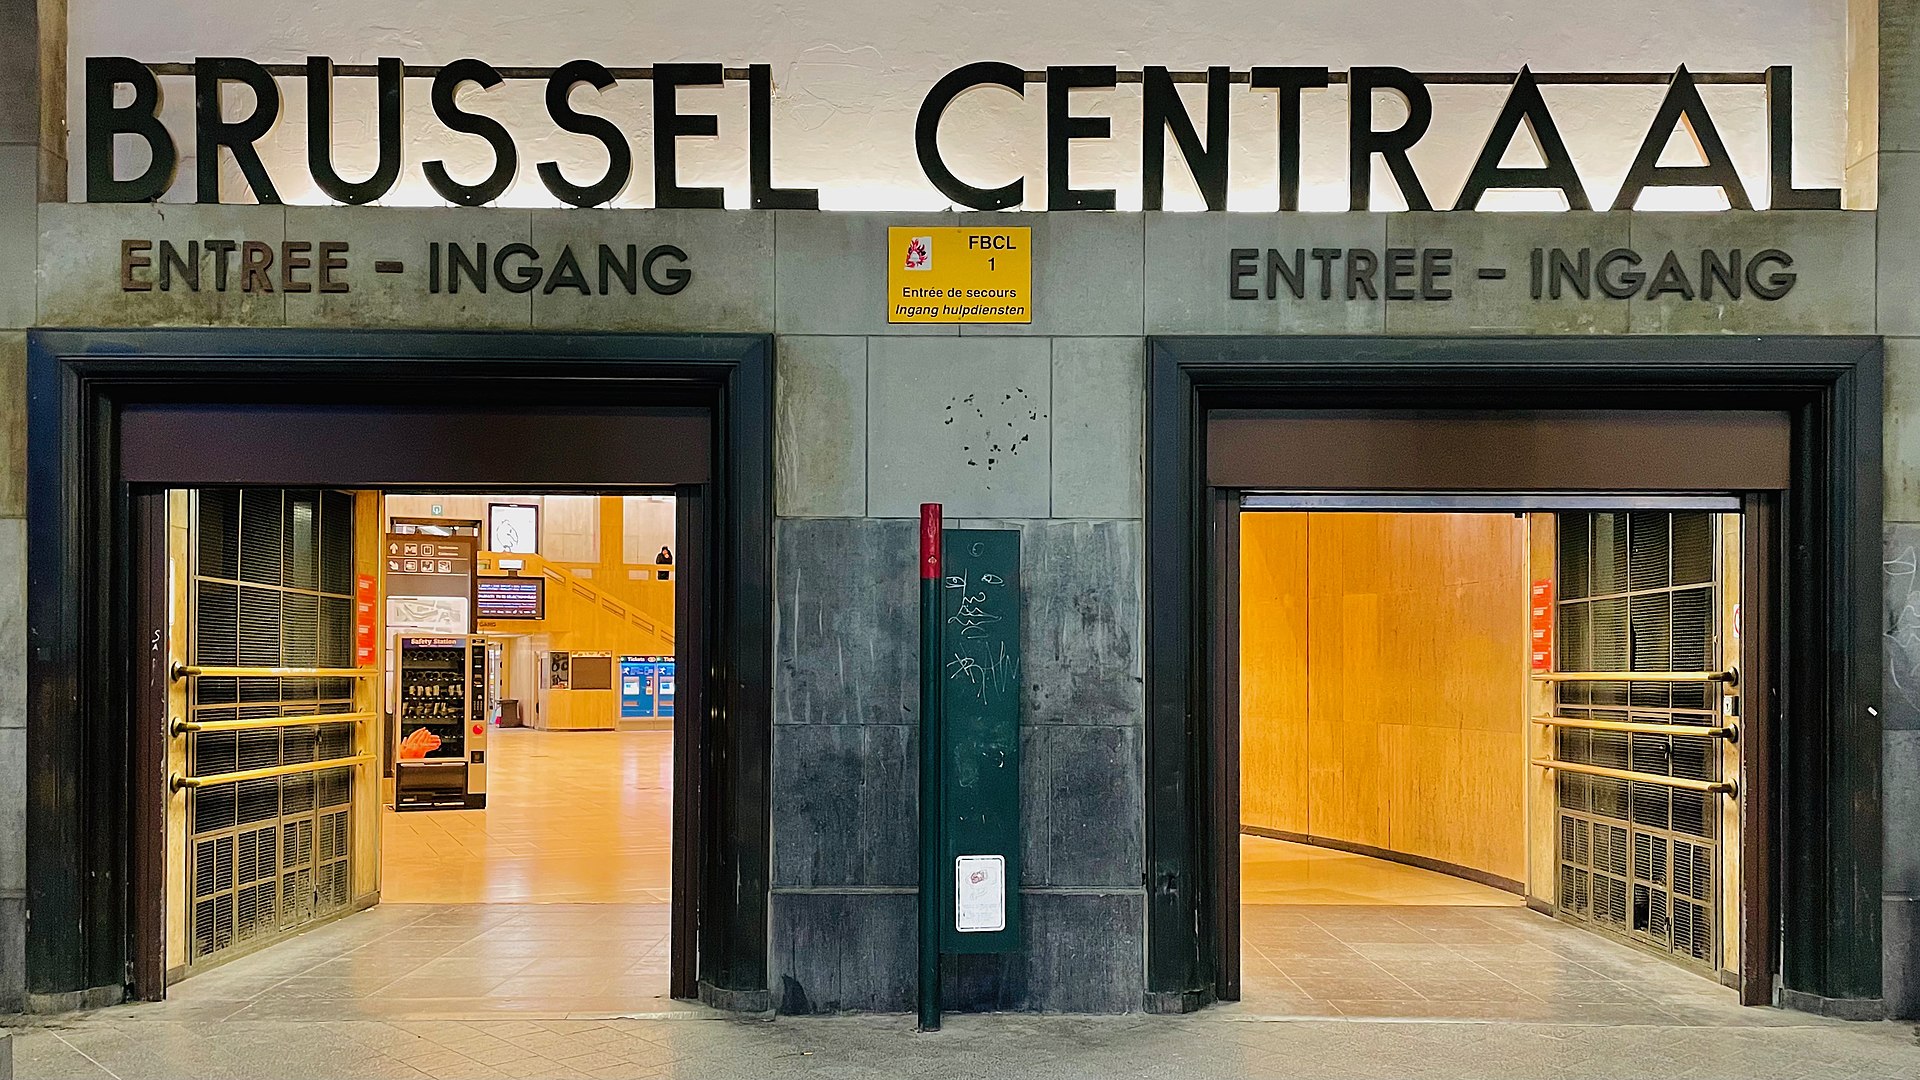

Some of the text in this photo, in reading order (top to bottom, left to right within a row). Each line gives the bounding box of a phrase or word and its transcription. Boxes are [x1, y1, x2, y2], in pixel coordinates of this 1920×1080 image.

[86, 56, 1842, 212] BRUSSEL CENTRAAL
[968, 235, 1017, 250] FBCL
[121, 239, 349, 292] ENTREE
[429, 241, 692, 296] INGANG
[987, 257, 996, 271] 1
[1230, 248, 1453, 300] ENTREE
[1530, 248, 1797, 301] INGANG
[902, 286, 1017, 298] Entrée de secours
[895, 304, 1025, 318] Ingang hulpdiensten
[411, 638, 432, 646] Safety
